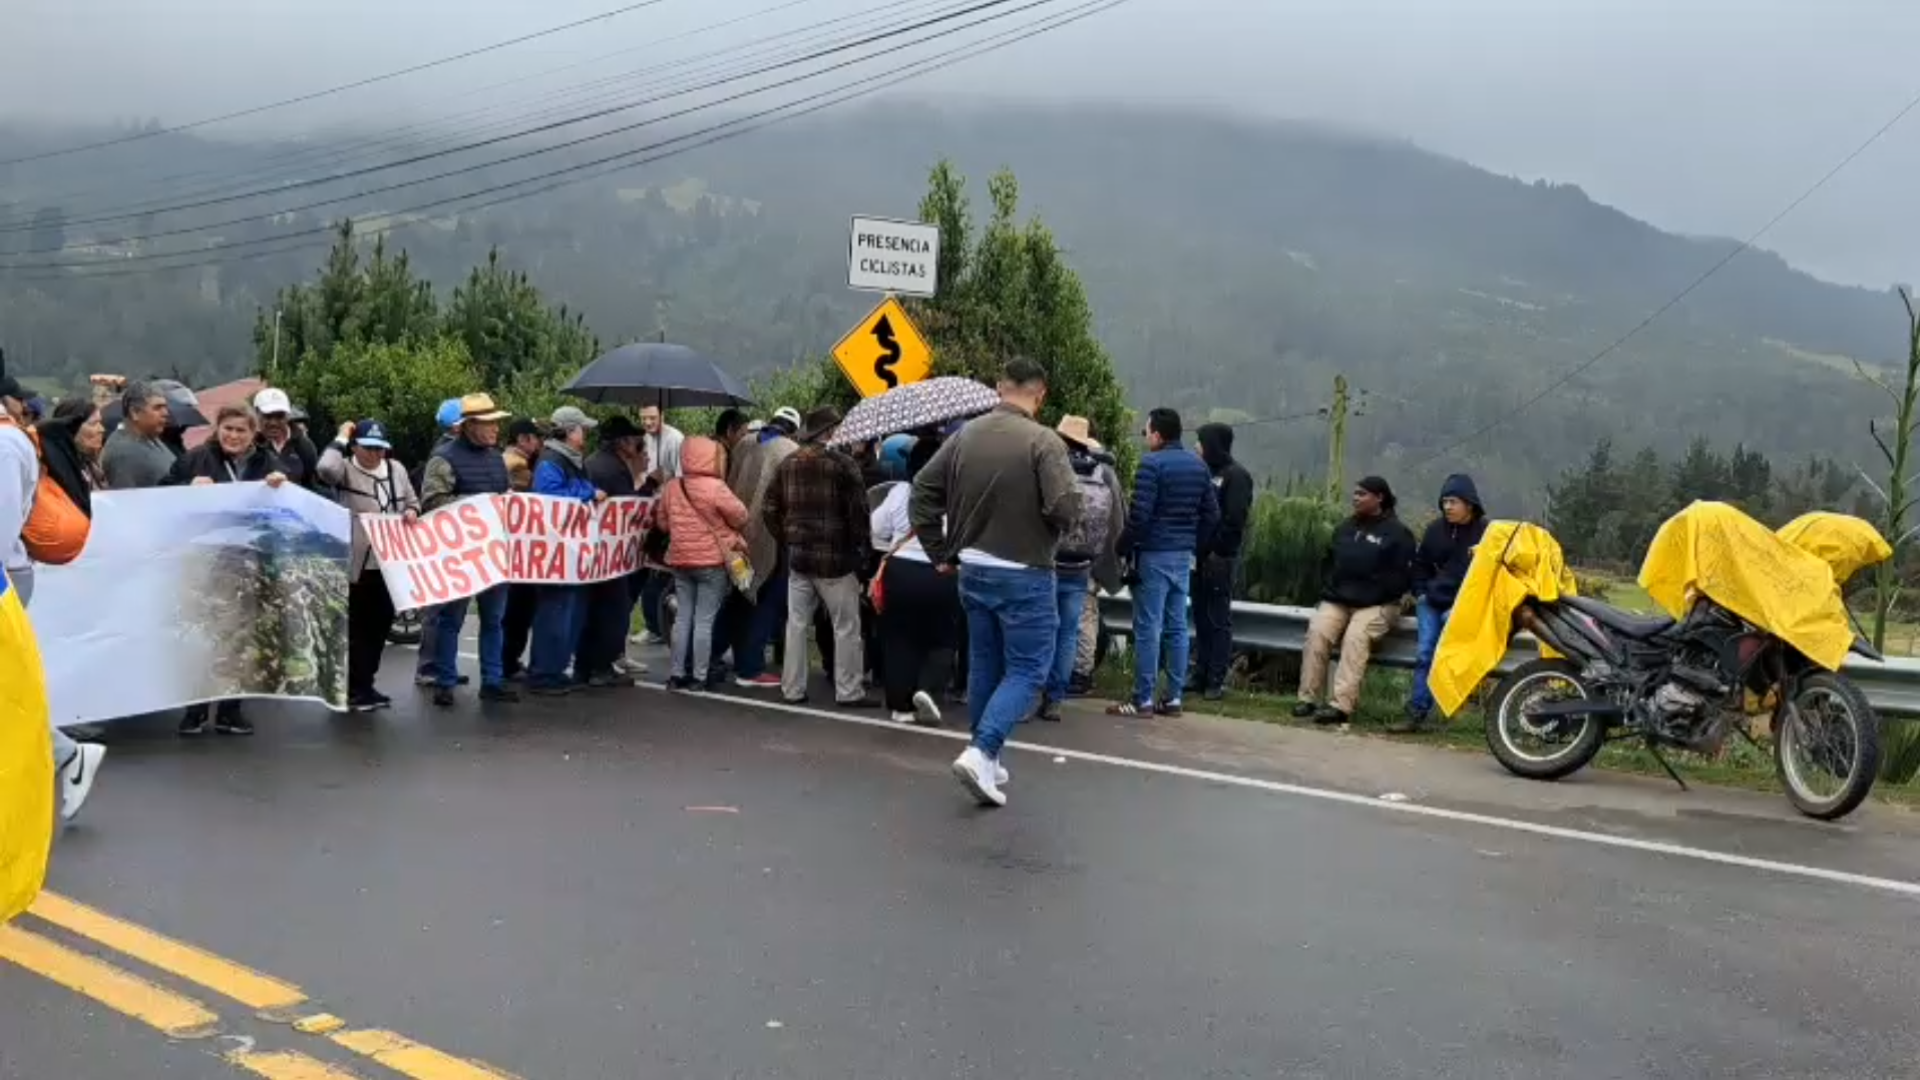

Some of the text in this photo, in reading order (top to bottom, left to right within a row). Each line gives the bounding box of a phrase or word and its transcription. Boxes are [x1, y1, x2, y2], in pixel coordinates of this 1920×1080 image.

[858, 233, 930, 253] PRESENCIA
[860, 258, 926, 278] CICLISTAS
[368, 503, 489, 561] UNIDOS
[507, 539, 566, 580] ARA
